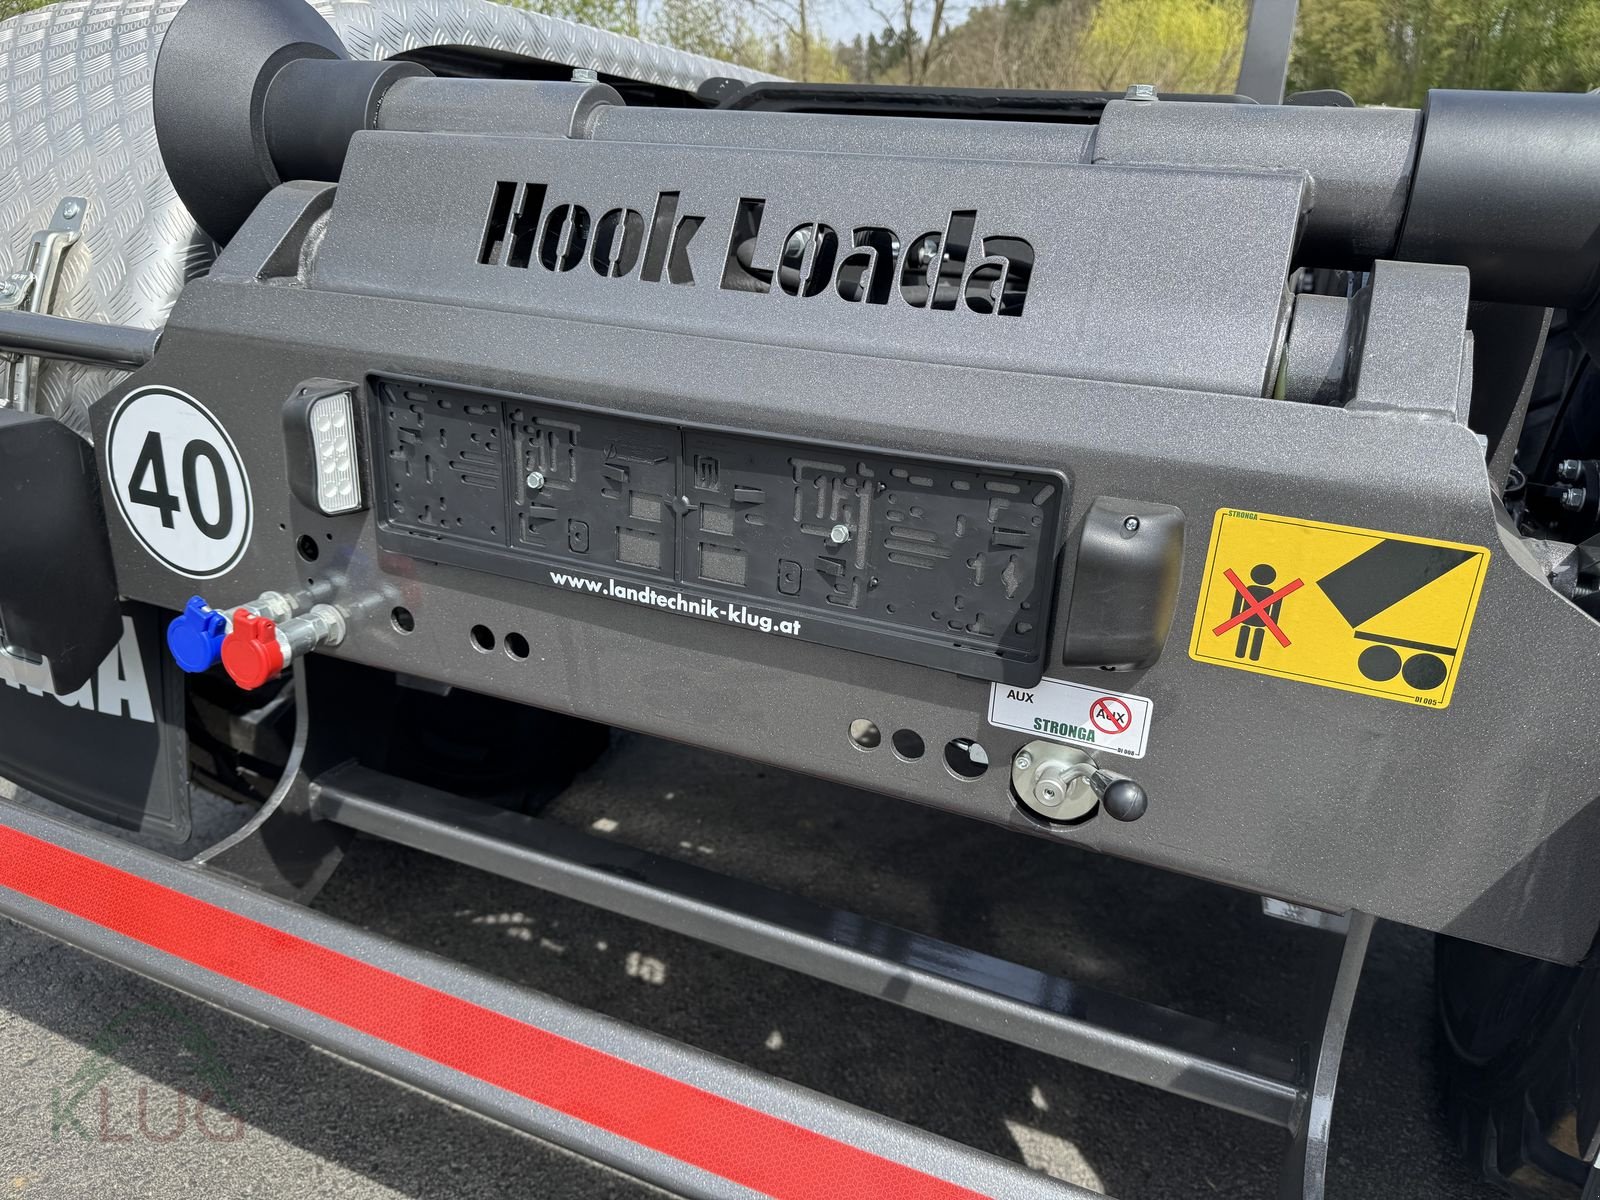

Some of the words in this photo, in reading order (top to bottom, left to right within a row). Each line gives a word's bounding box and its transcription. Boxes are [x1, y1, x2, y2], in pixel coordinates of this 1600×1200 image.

[476, 180, 706, 287] Hook
[719, 196, 1035, 318] Loada
[128, 430, 233, 540] 40
[1228, 509, 1258, 521] STRONGA
[549, 571, 802, 636] www.landtechnik-klug.at
[1007, 689, 1035, 704] AUX
[1033, 717, 1096, 743] STRONGA
